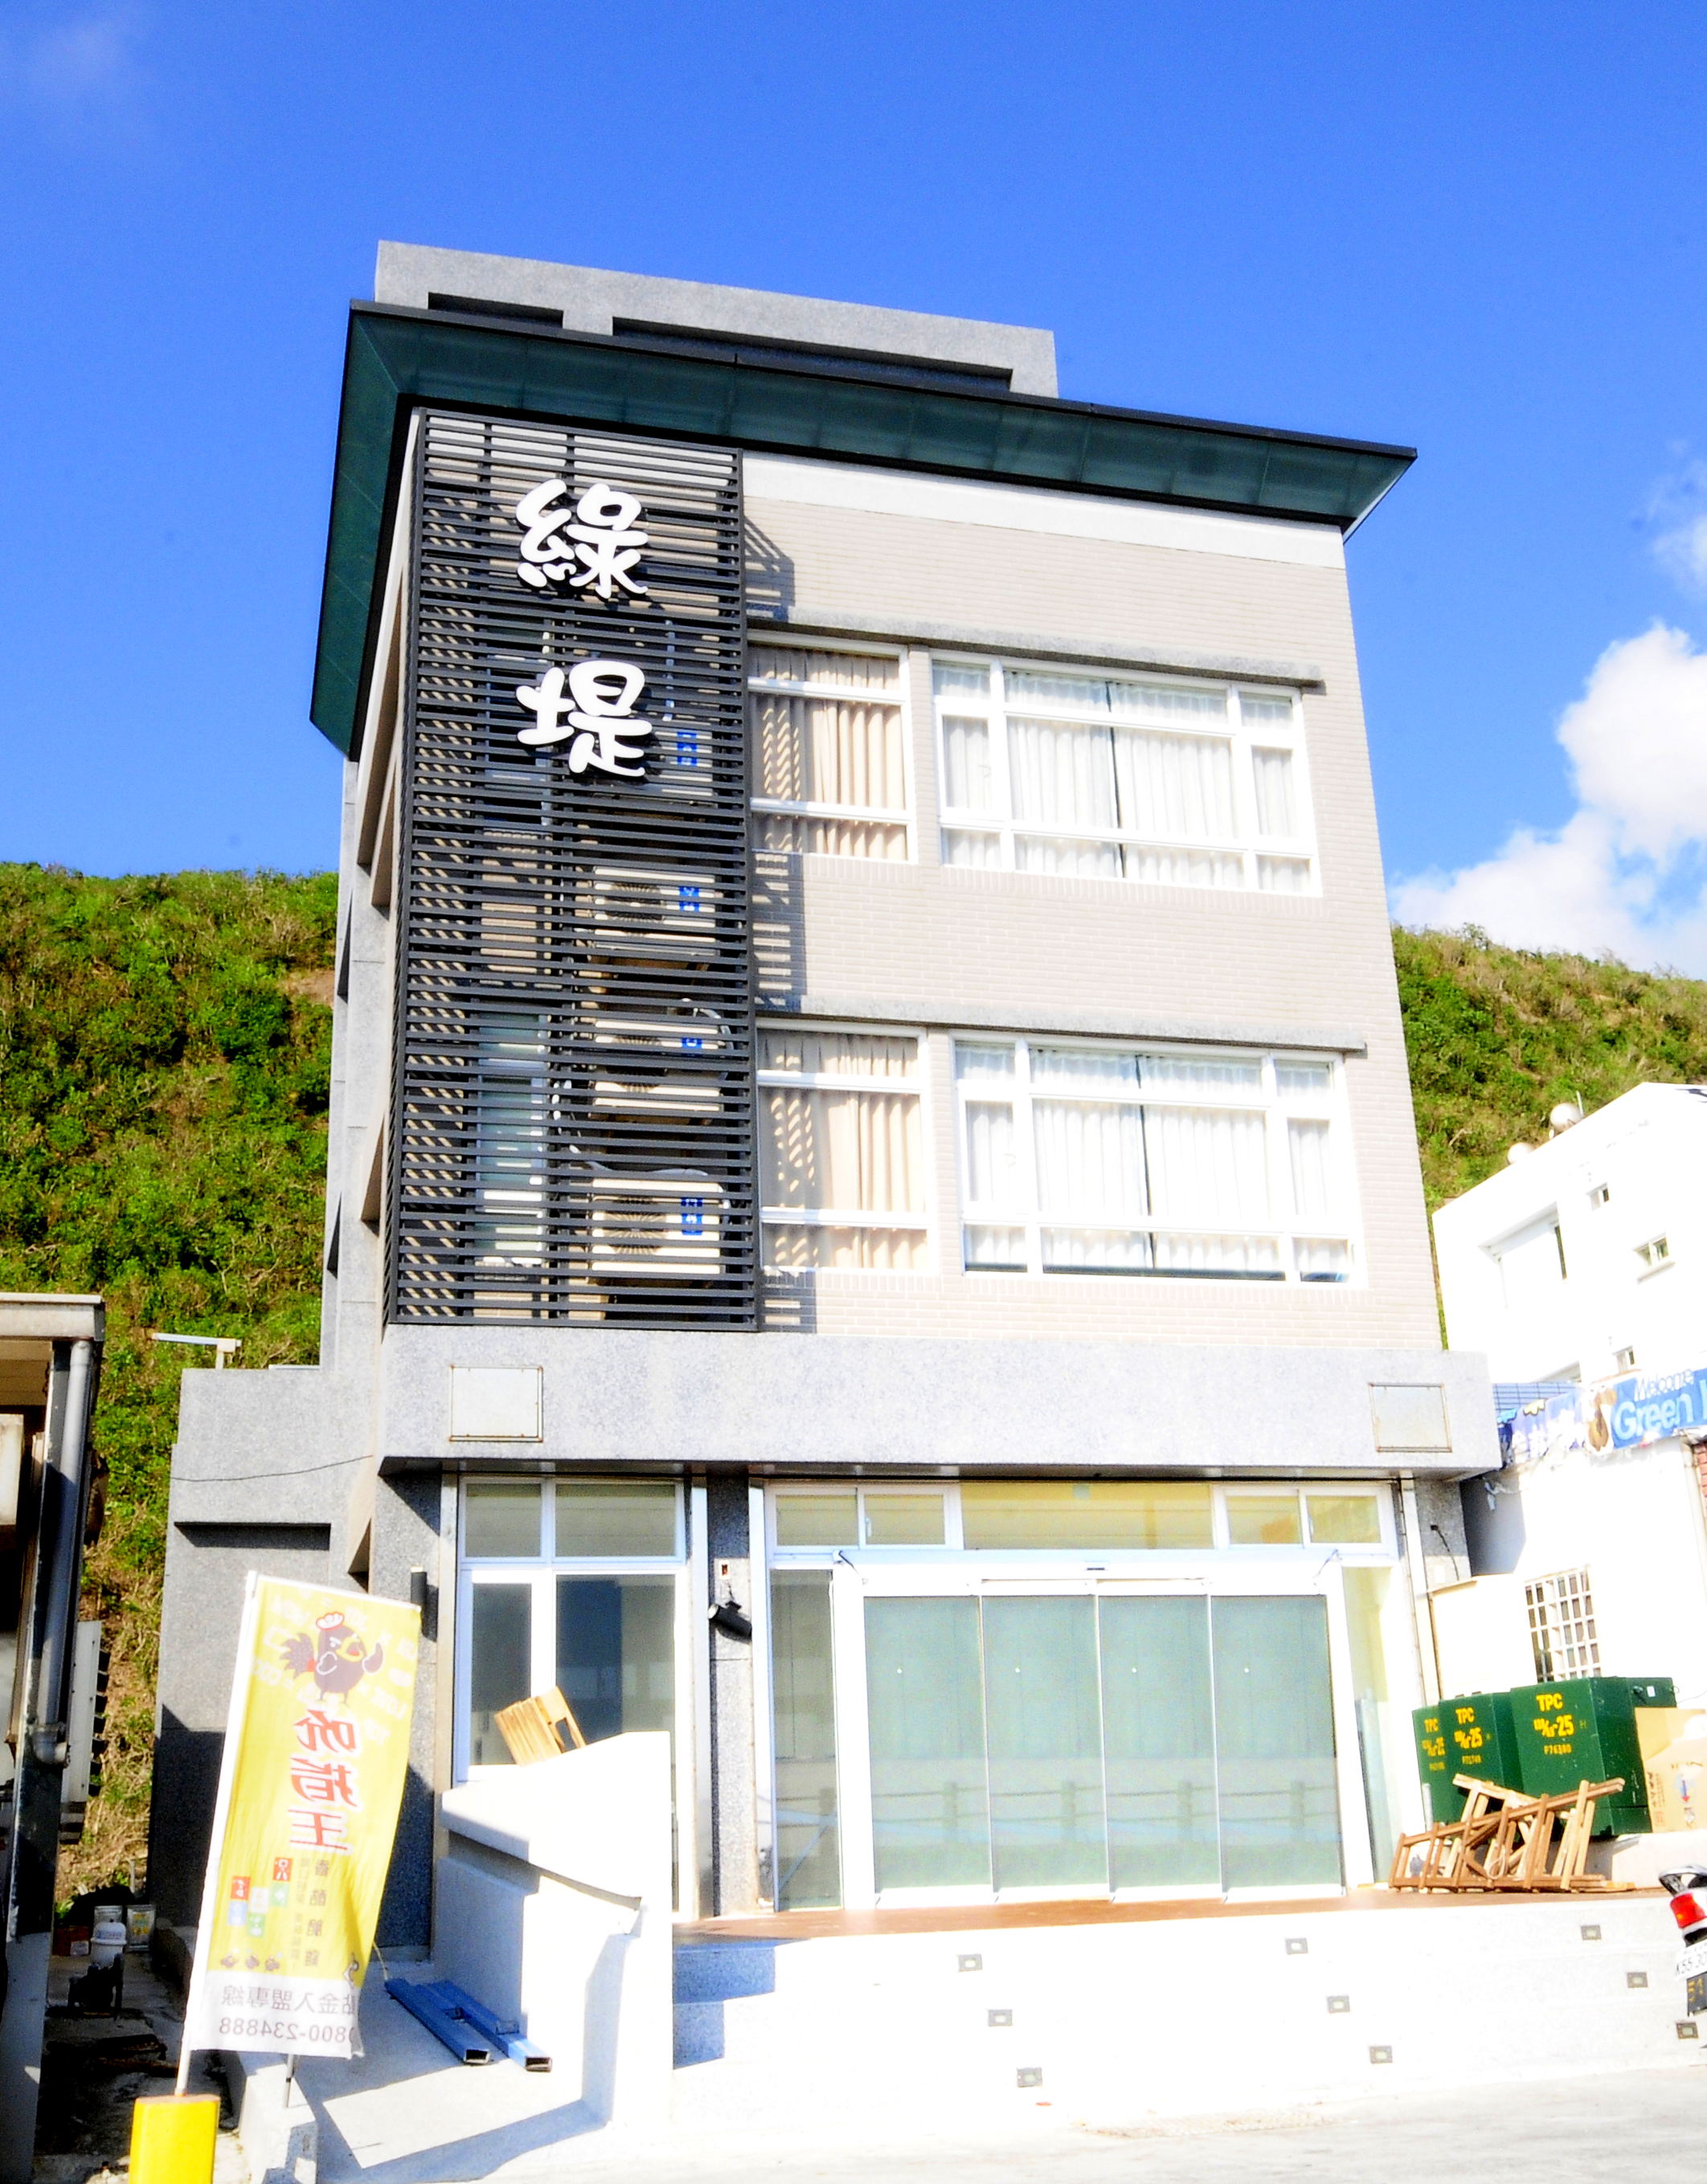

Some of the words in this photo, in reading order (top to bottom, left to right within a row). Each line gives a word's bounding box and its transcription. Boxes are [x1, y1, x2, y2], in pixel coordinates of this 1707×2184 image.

[1613, 1393, 1693, 1440] Green
[1536, 1693, 1563, 1712] TPC
[1455, 1708, 1474, 1724] TPC
